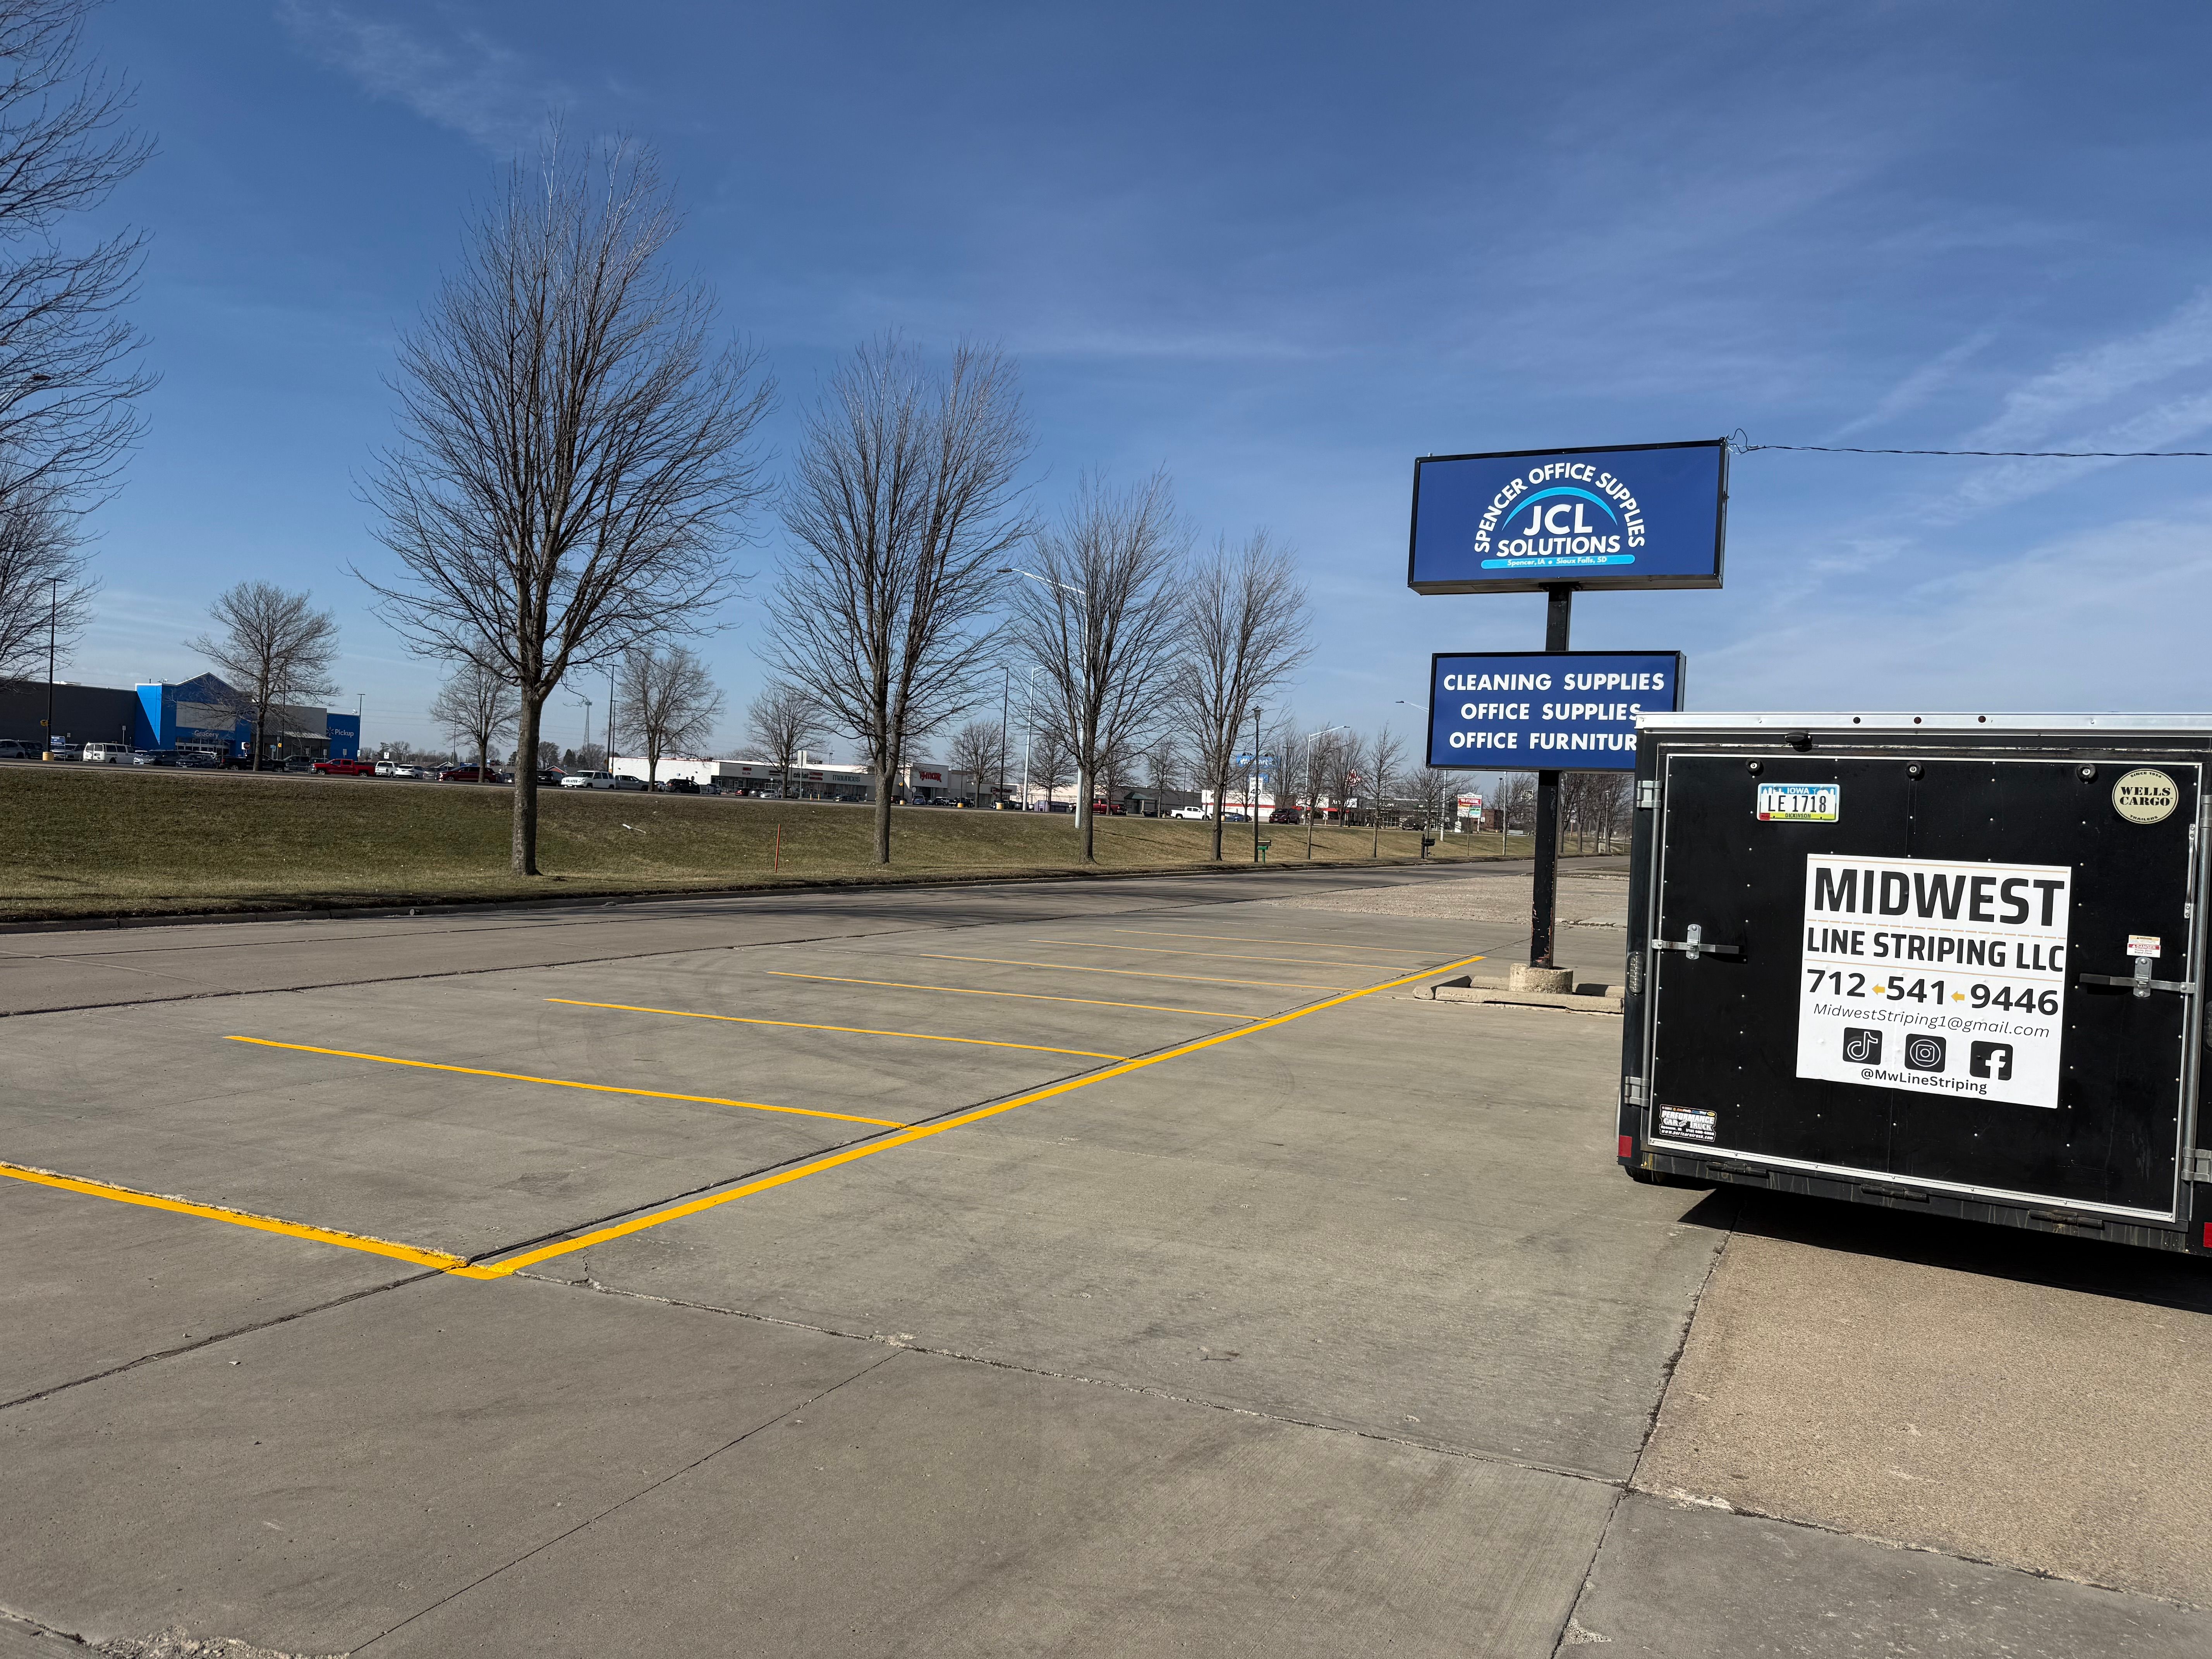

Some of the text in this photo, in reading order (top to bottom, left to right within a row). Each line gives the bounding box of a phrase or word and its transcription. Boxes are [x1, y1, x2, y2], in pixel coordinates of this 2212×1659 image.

[1474, 463, 1645, 553] SPENCER OFFICE SUPPLIES
[1523, 503, 1593, 536] JCL
[1496, 535, 1621, 558] SOLUTIONS
[1443, 673, 1664, 691] CLEANING SUPPLIES
[1461, 703, 1641, 721] OFFICE SUPPLIES
[194, 730, 219, 740] Grocery
[335, 728, 354, 738] Pickup
[1449, 732, 1637, 751] OFFICE FURNITUR
[2121, 787, 2171, 796] WELLS
[1768, 795, 1826, 813] LE 1718
[2119, 796, 2170, 806] CARGO
[1814, 867, 2065, 927] MIDWEST
[1807, 927, 2064, 972] LINE STRIPING LLC
[1807, 969, 2058, 1015] 712 541 9446
[1814, 1003, 2050, 1038] MidwestStriping1@gmail.com
[1861, 1068, 1987, 1095] @MwLineStriping
[1661, 1110, 1715, 1125] PERFORMANCE
[1663, 1118, 1680, 1127] CAR
[1690, 1120, 1713, 1132] TRUCK
